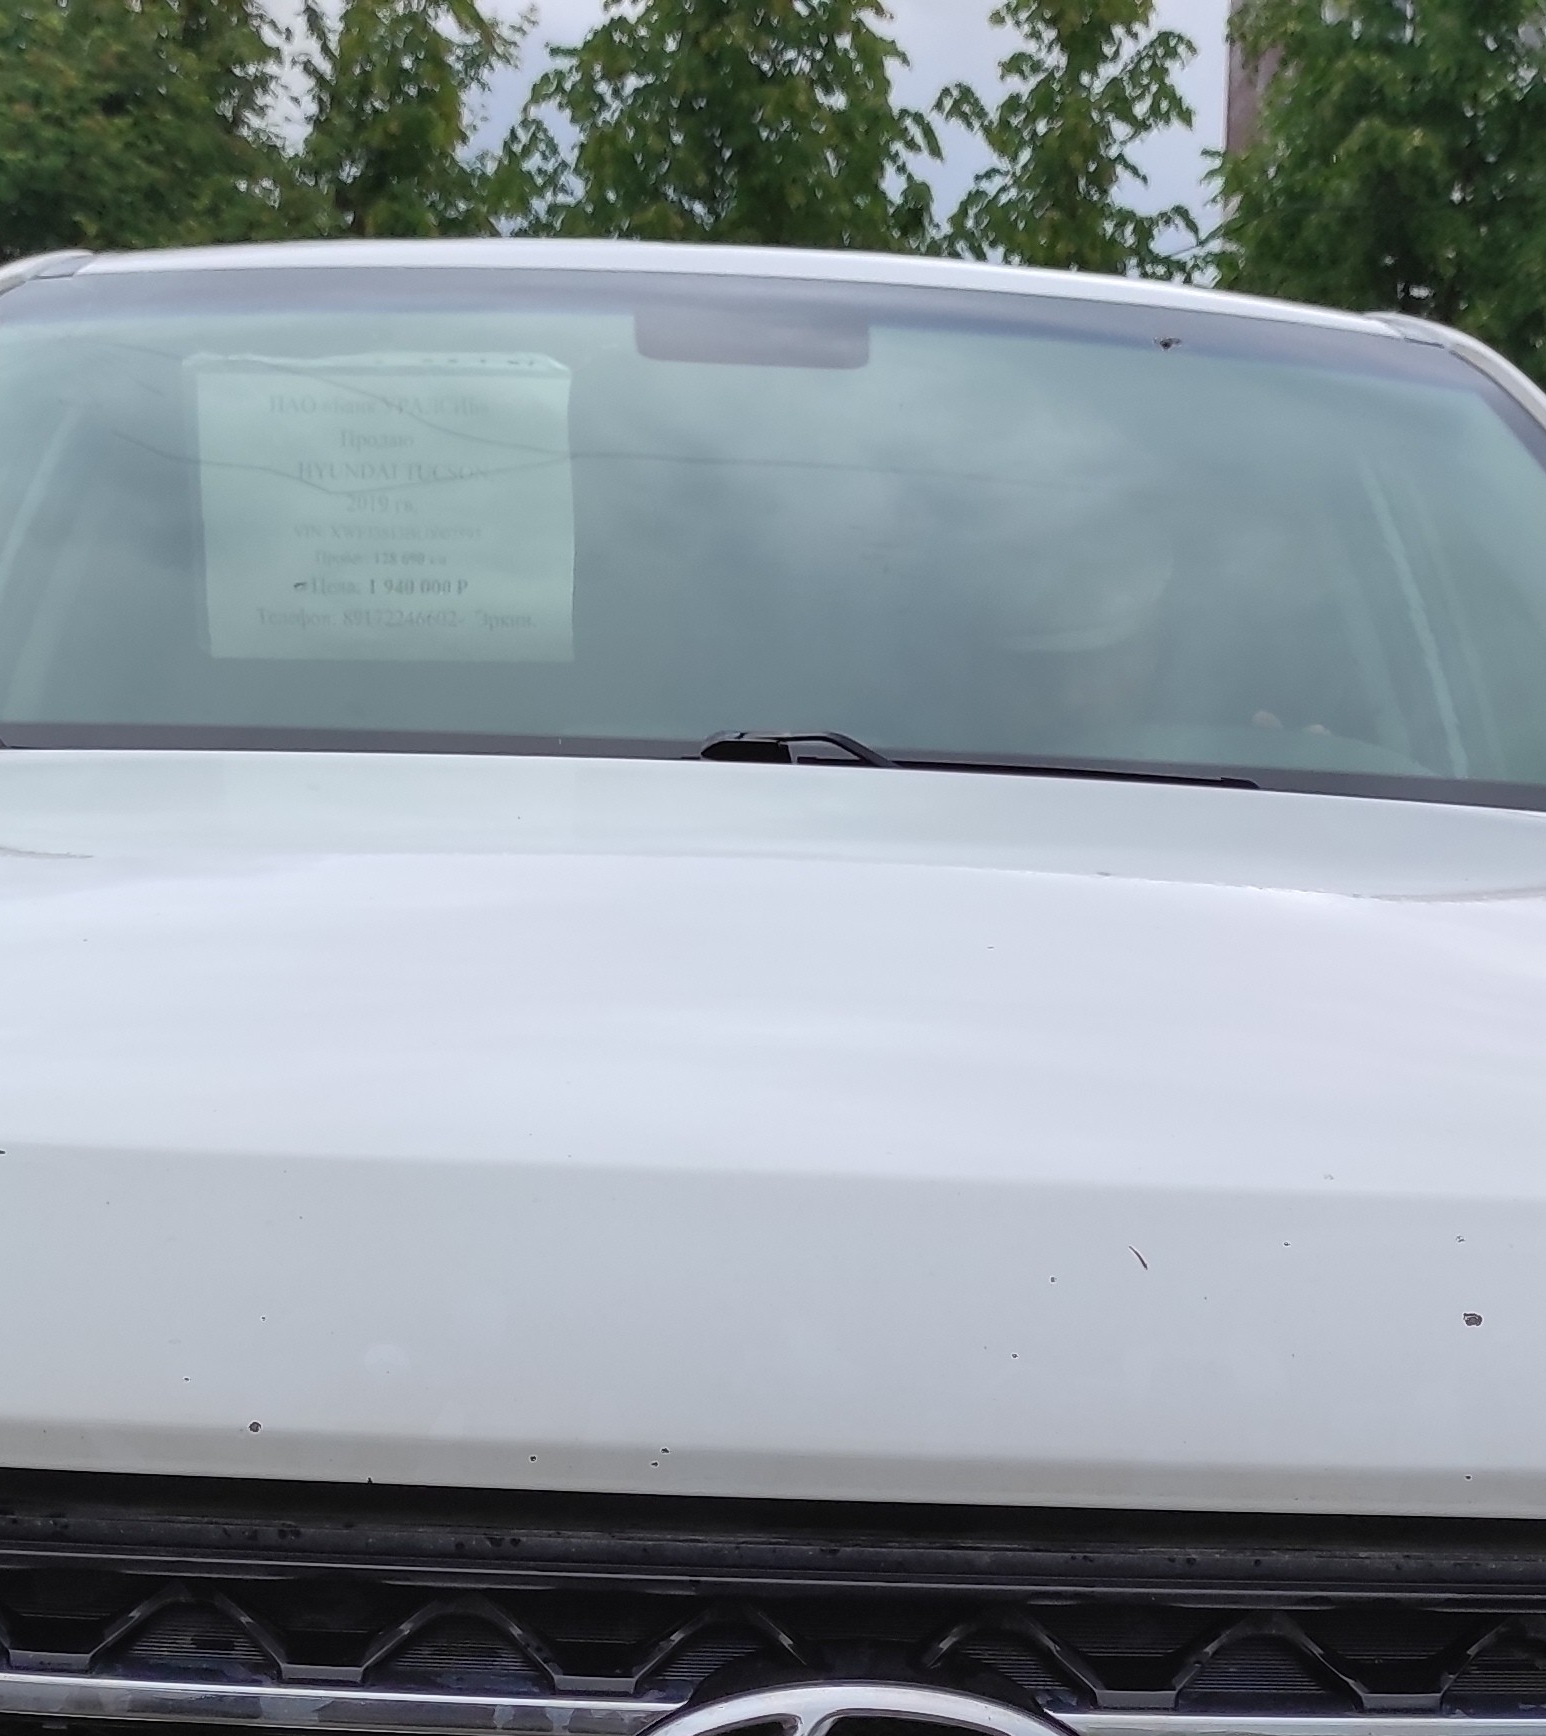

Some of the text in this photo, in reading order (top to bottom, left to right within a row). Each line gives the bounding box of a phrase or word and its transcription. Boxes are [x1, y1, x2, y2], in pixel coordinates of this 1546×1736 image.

[340, 430, 414, 451] Продаю
[297, 462, 489, 482] HYUNDAI TUCSON
[347, 493, 390, 513] 2019
[419, 578, 452, 595] 000
